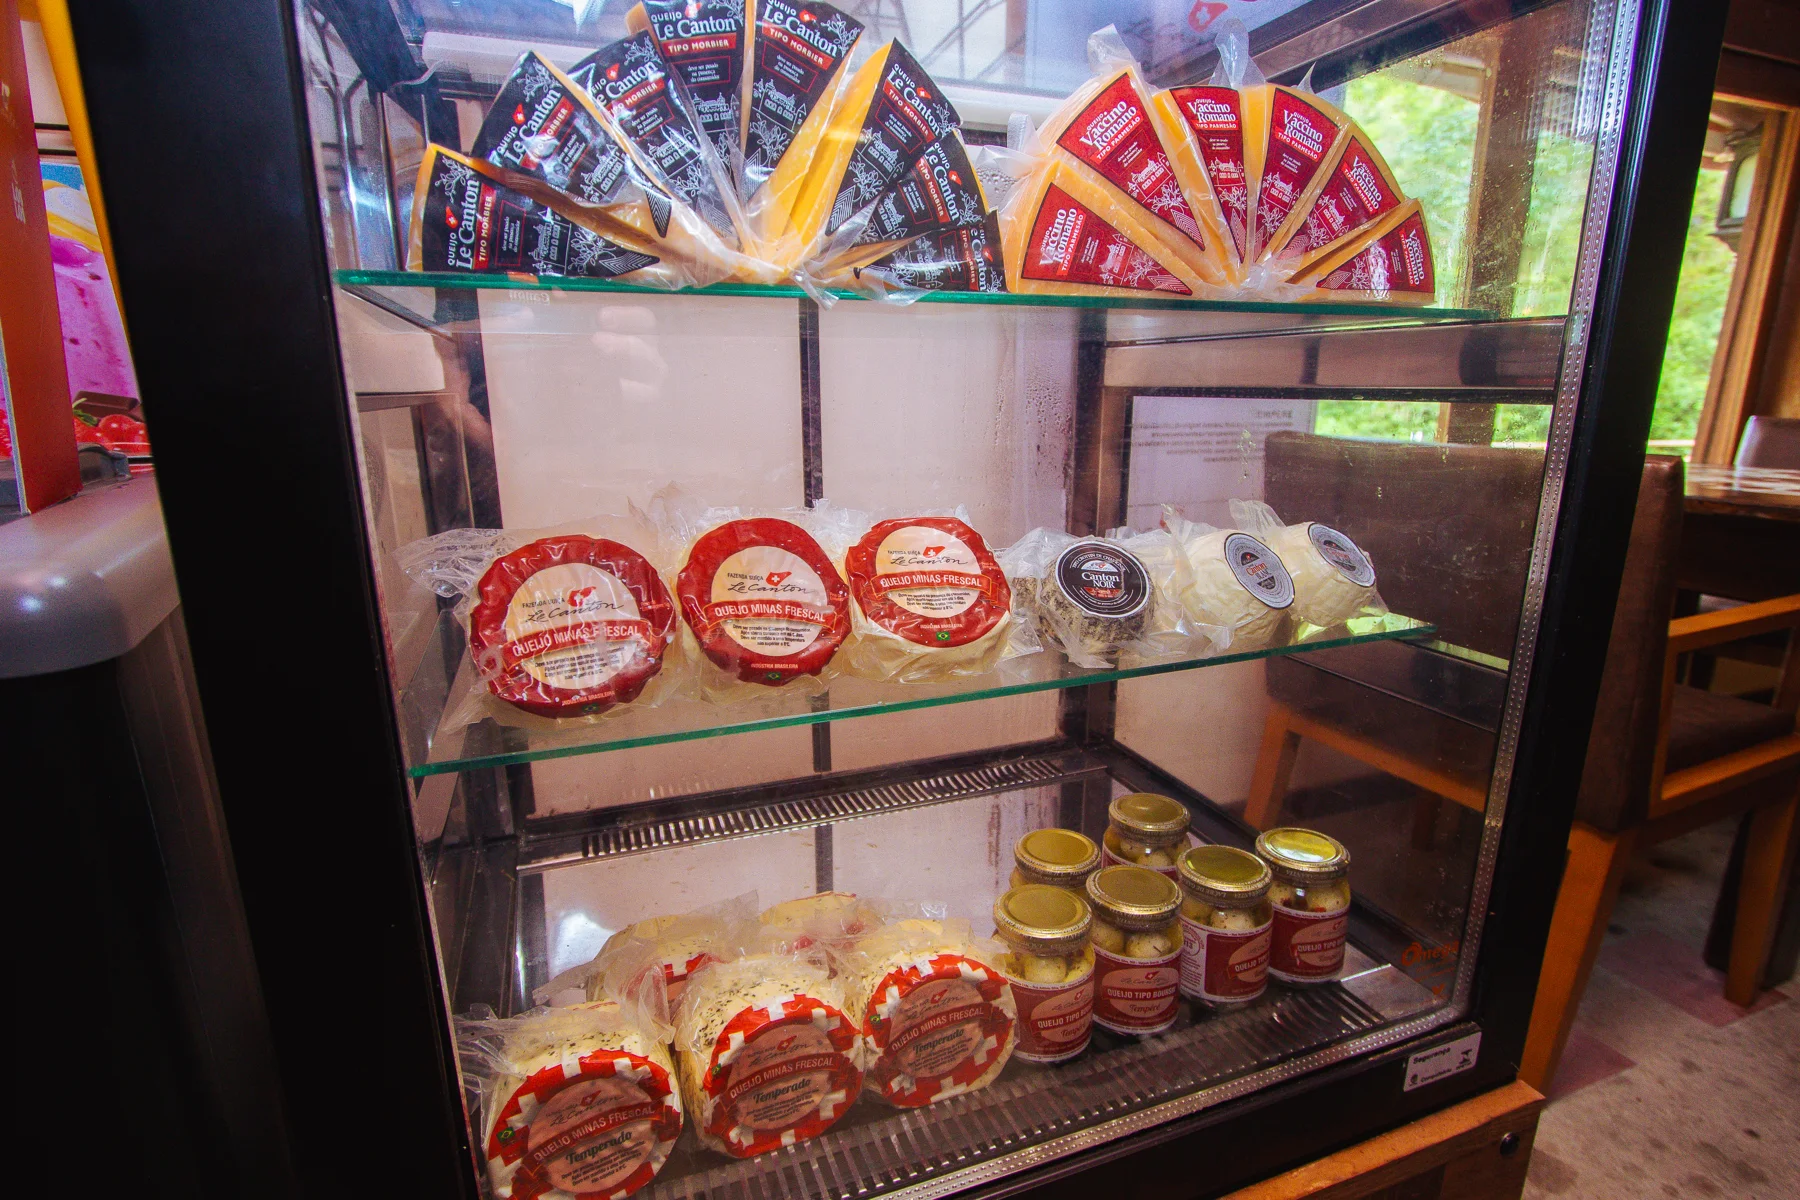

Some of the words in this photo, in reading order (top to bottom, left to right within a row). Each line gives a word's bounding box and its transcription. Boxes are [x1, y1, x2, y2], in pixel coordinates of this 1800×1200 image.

[651, 11, 682, 23] QUEIJO
[768, 0, 797, 16] QUEIJO
[653, 23, 675, 40] Le
[677, 16, 737, 37] Canton
[763, 3, 784, 24] Le
[786, 16, 838, 58] Canton
[668, 44, 689, 54] TIPO
[691, 39, 729, 51] MORBIER
[769, 28, 789, 43] TIPO
[790, 39, 824, 65] MORBIER
[596, 93, 607, 107] e
[606, 61, 659, 99] Canton
[894, 63, 916, 88] QUEIJO
[625, 82, 658, 106] MORBIER
[887, 68, 903, 90] Le
[904, 86, 940, 137] Canton
[1187, 100, 1231, 114] Vaccino
[889, 89, 903, 107] TIPO
[904, 106, 929, 136] MORBIER
[1079, 101, 1127, 146] Vaccino
[1086, 113, 1104, 131] QUEIJO
[1197, 112, 1236, 123] Romano
[1284, 109, 1323, 143] Vaccino
[1293, 111, 1309, 124] QUEIJO
[497, 126, 518, 153] QUEIJO
[504, 140, 525, 165] Le
[519, 89, 561, 141] Canton
[1093, 106, 1137, 151] Romano
[1097, 145, 1111, 160] TIPO
[1111, 116, 1141, 146] PARMESÃO
[1284, 123, 1323, 153] Romano
[934, 142, 950, 169] QUEIJO
[1278, 132, 1291, 143] TIPO
[1291, 140, 1318, 159] PARMESÃO
[918, 161, 930, 180] TIPO
[928, 182, 944, 217] MORBIER
[924, 146, 939, 164] Le
[934, 165, 960, 221] Canton
[1344, 168, 1354, 182] TIPO
[1353, 181, 1373, 212] PARMESÃO
[1350, 166, 1379, 210] Romano
[1352, 155, 1382, 201] Vaccino
[458, 179, 480, 244] Canton
[481, 196, 493, 238] MORBIER
[971, 228, 979, 237] e
[1039, 209, 1067, 265] Vaccino
[1053, 208, 1077, 263] Romano
[1062, 254, 1071, 271] TIPO
[1068, 214, 1084, 253] PARMESÃO
[447, 232, 457, 266] QUEIJO
[456, 247, 474, 269] Le
[479, 239, 487, 262] TIPO
[1405, 238, 1420, 285] Romano
[1409, 228, 1425, 280] Vaccino
[971, 239, 988, 291] Canton
[890, 556, 908, 566] Le
[908, 555, 968, 565] Canton
[727, 572, 748, 580] FAZENDA
[728, 581, 748, 593] Le
[748, 583, 817, 594] Canton
[880, 575, 911, 588] QUEIJO
[912, 574, 941, 584] MINAS
[943, 575, 982, 587] FRESCAL
[1081, 571, 1119, 582] Canton
[1093, 580, 1115, 588] NOIR
[548, 601, 624, 618] Canton
[715, 605, 749, 617] QUEIJO
[751, 603, 782, 614] MINAS
[785, 605, 825, 621] FRESCAL
[512, 635, 552, 657] QUEIJO
[554, 627, 591, 644] MINAS
[1297, 944, 1322, 952] QUEIJO
[1234, 960, 1257, 972] QUEIJO
[1107, 988, 1133, 998] QUEIJO
[891, 1029, 920, 1052] QUEIJO
[920, 1015, 947, 1034] MINAS
[949, 1006, 984, 1022] FRESCAL
[1037, 1018, 1064, 1029] QUEIJO
[1065, 1011, 1080, 1023] TIPO
[912, 1028, 964, 1055] Temperado
[730, 1074, 762, 1099] QUEIJO
[763, 1063, 793, 1080] MINAS
[795, 1057, 834, 1071] FRESCAL
[753, 1078, 812, 1105] Temperado
[533, 1135, 571, 1162] QUEIJO
[572, 1117, 607, 1140] MINAS
[608, 1107, 656, 1124] FRESCAL
[565, 1130, 633, 1165] Temperado
